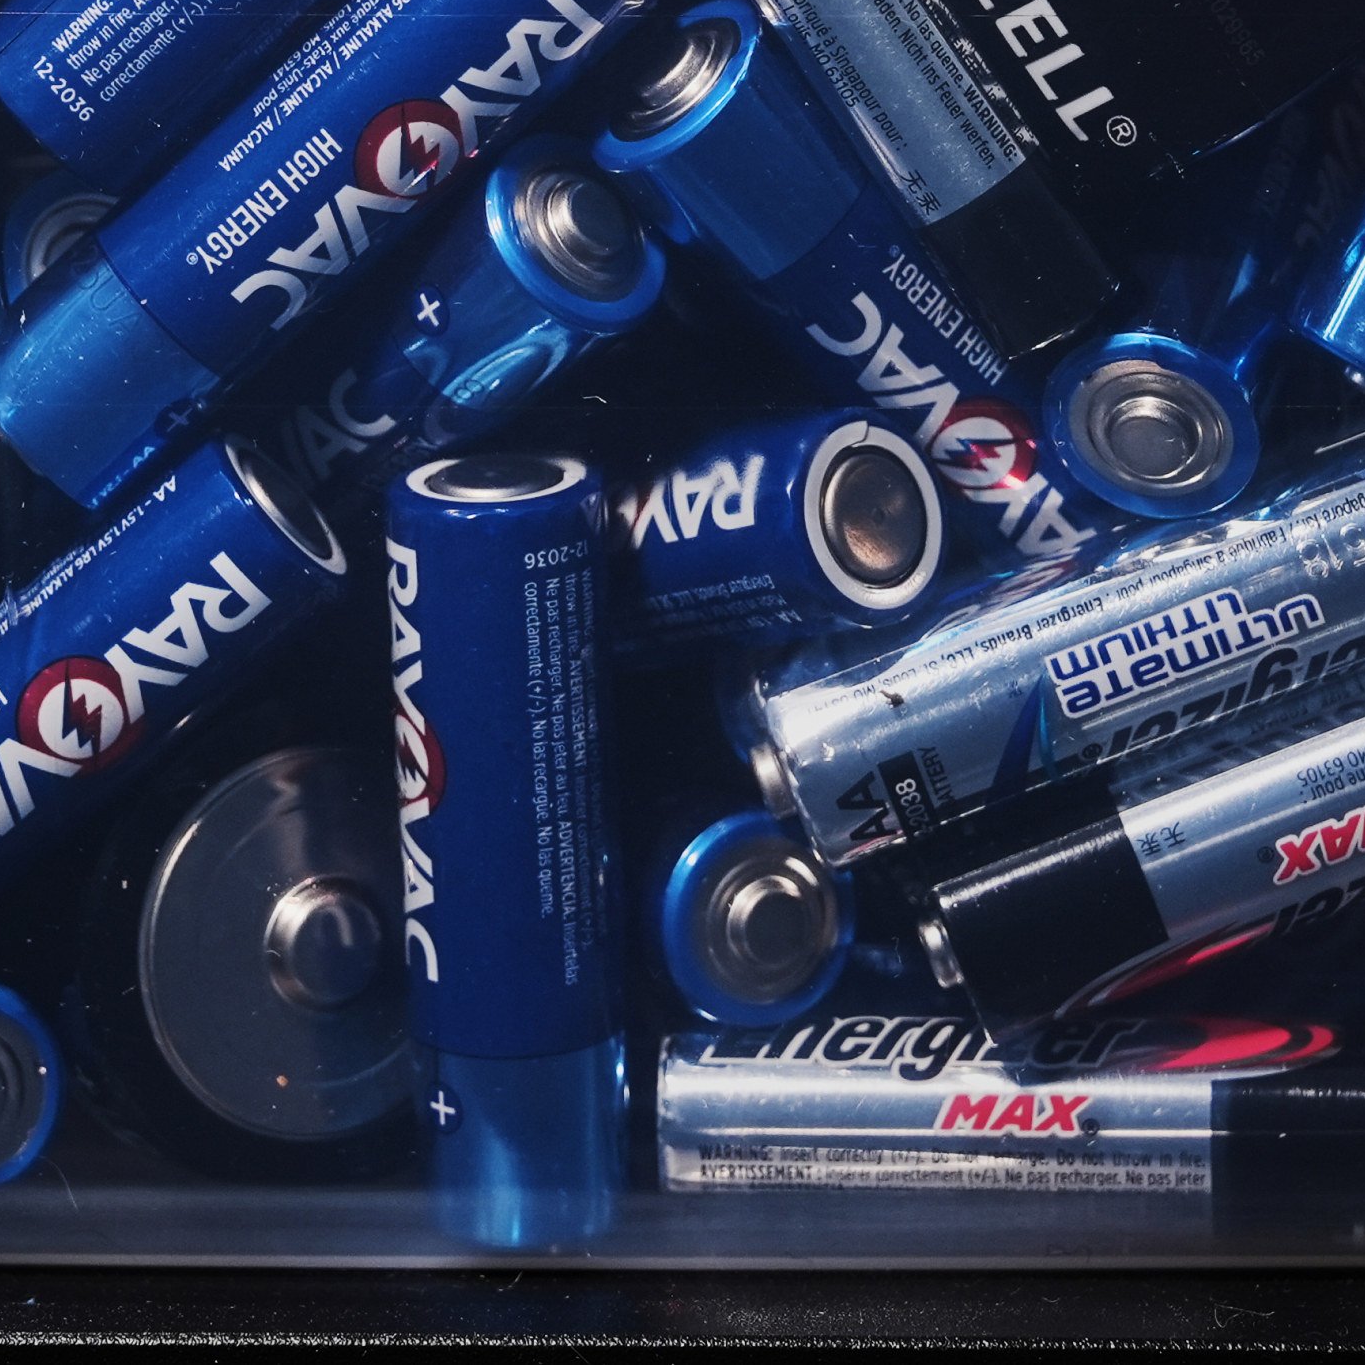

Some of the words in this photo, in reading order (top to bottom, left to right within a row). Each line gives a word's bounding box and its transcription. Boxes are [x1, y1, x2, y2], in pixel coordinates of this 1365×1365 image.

[64, 33, 104, 72] throw
[94, 22, 116, 43] in
[106, 4, 140, 32] fire.
[336, 1, 396, 62] ALKALINE
[821, 33, 840, 50] à
[30, 53, 97, 124] 12-2036
[78, 64, 105, 89] Ne
[96, 46, 125, 76] pas
[96, 26, 178, 104] correctamente
[271, 58, 336, 120] ALCALINE
[821, 64, 862, 110] 63105
[827, 43, 884, 114] Singapour
[915, 17, 937, 43] las
[928, 38, 967, 91] queme.
[961, 82, 1020, 164] WARNUNG:
[871, 109, 905, 145] pour
[896, 26, 930, 68] Nicht
[919, 59, 943, 87] ins
[932, 79, 968, 122] Feuer
[958, 116, 998, 171] werfen.
[216, 113, 277, 174] ALCALINA
[274, 125, 345, 195] HIGH
[898, 166, 944, 218] 无汞
[948, 320, 1016, 389] HIGH
[1047, 590, 1248, 683] LITHIUM
[1132, 818, 1188, 859] 无汞
[939, 1091, 1091, 1134] MAX
